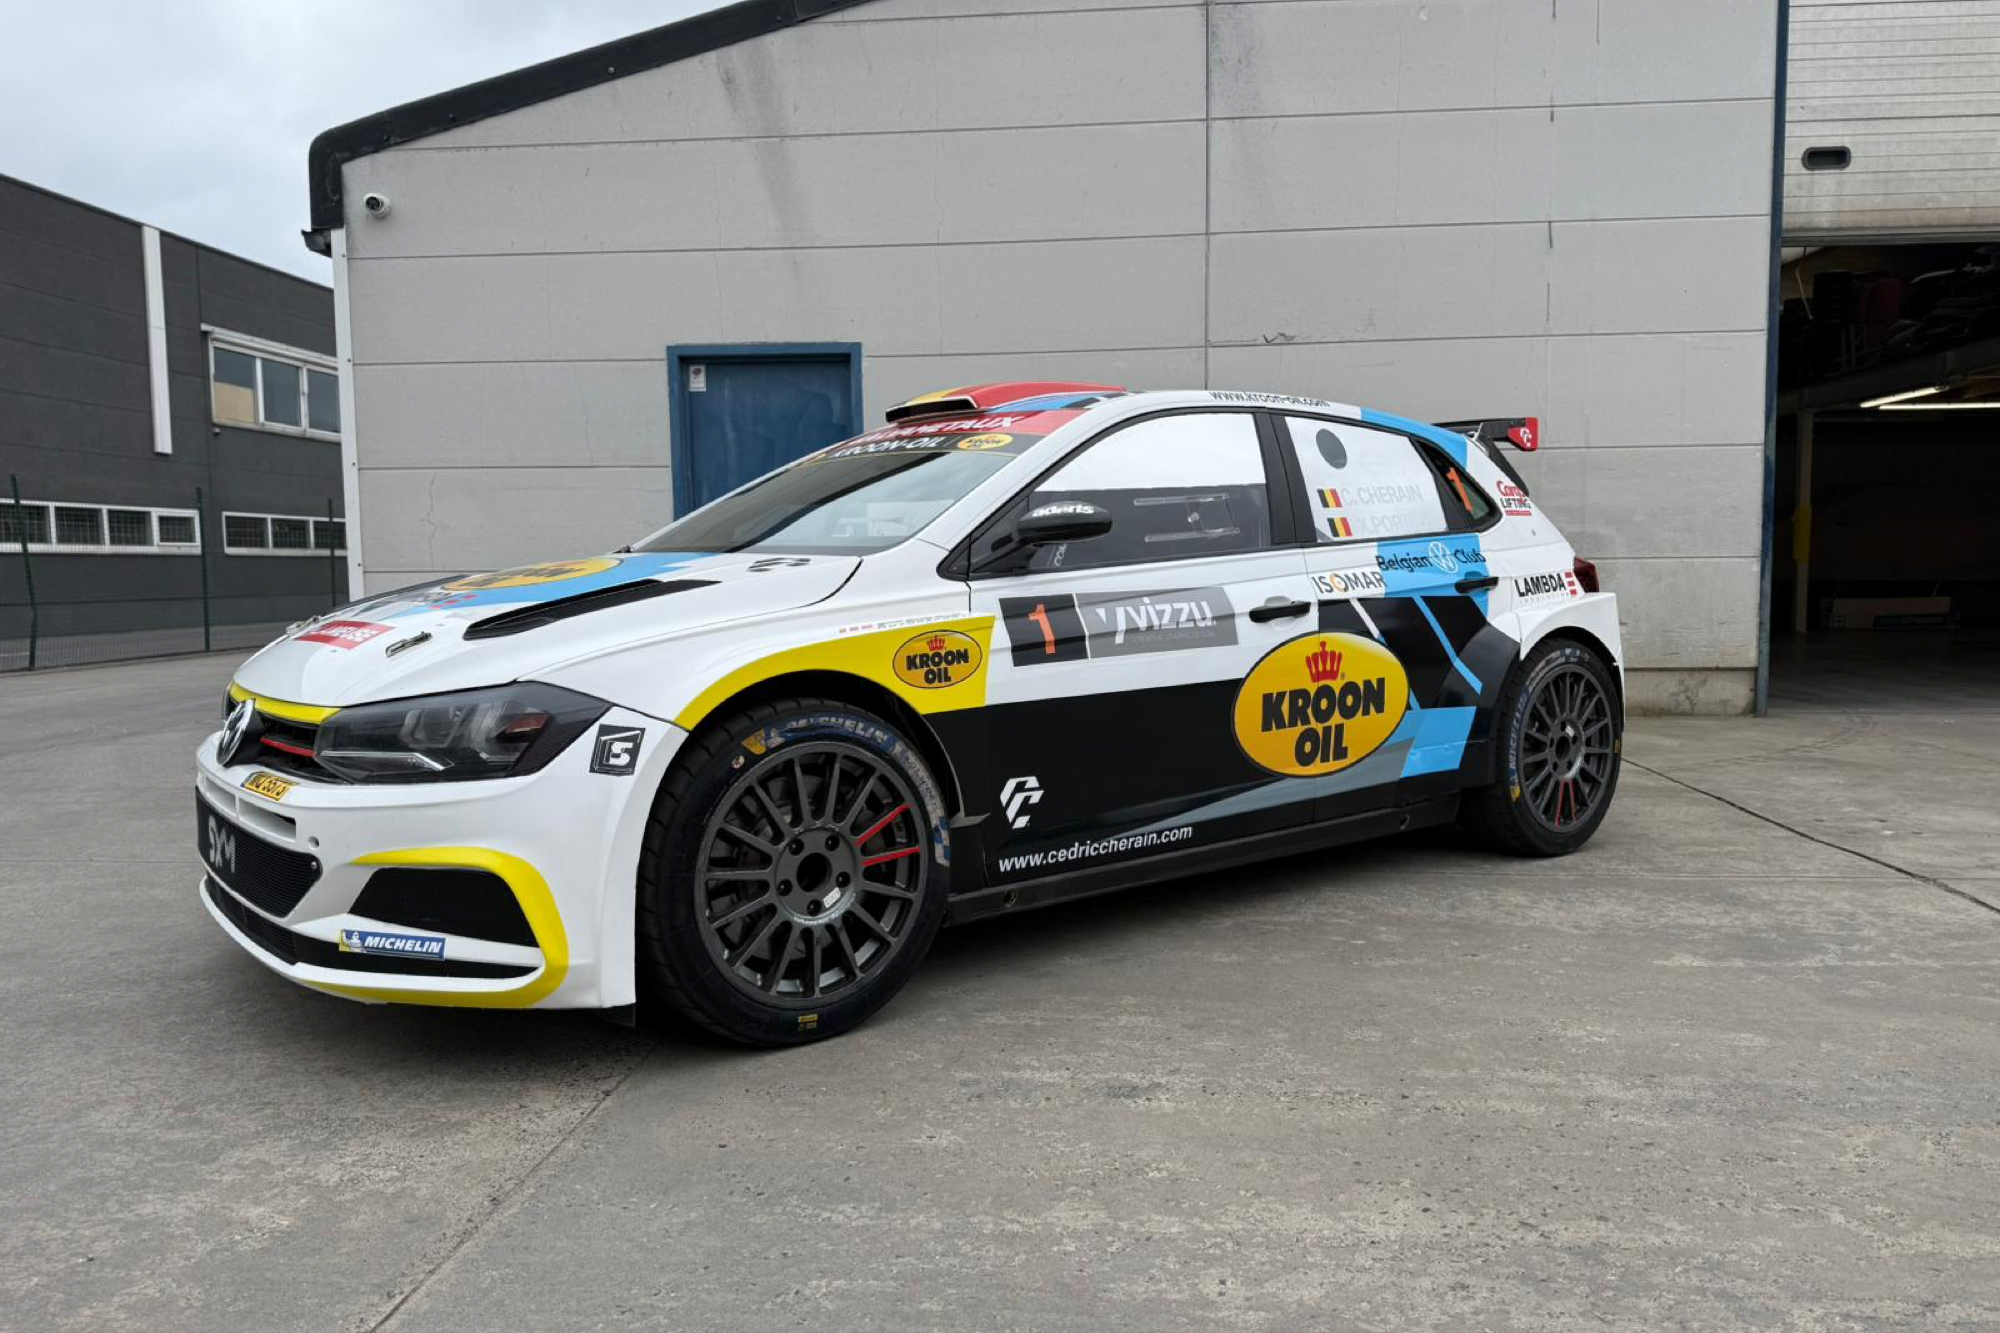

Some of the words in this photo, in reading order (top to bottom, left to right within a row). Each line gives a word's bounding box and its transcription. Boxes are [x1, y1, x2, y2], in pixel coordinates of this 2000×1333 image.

[1357, 484, 1423, 505] CHERAIN
[1375, 552, 1432, 573] Belgian
[1454, 548, 1486, 564] Club
[1311, 571, 1388, 594] ISOMAR
[1514, 572, 1567, 597] LAMBDA
[1028, 602, 1056, 654] 1
[905, 648, 970, 671] KROON
[923, 667, 952, 685] OIL
[1261, 677, 1386, 733] KROON
[1295, 723, 1349, 767] OIL
[998, 826, 1193, 872] www.cedriccherain.com
[364, 935, 443, 954] MICHELIN
